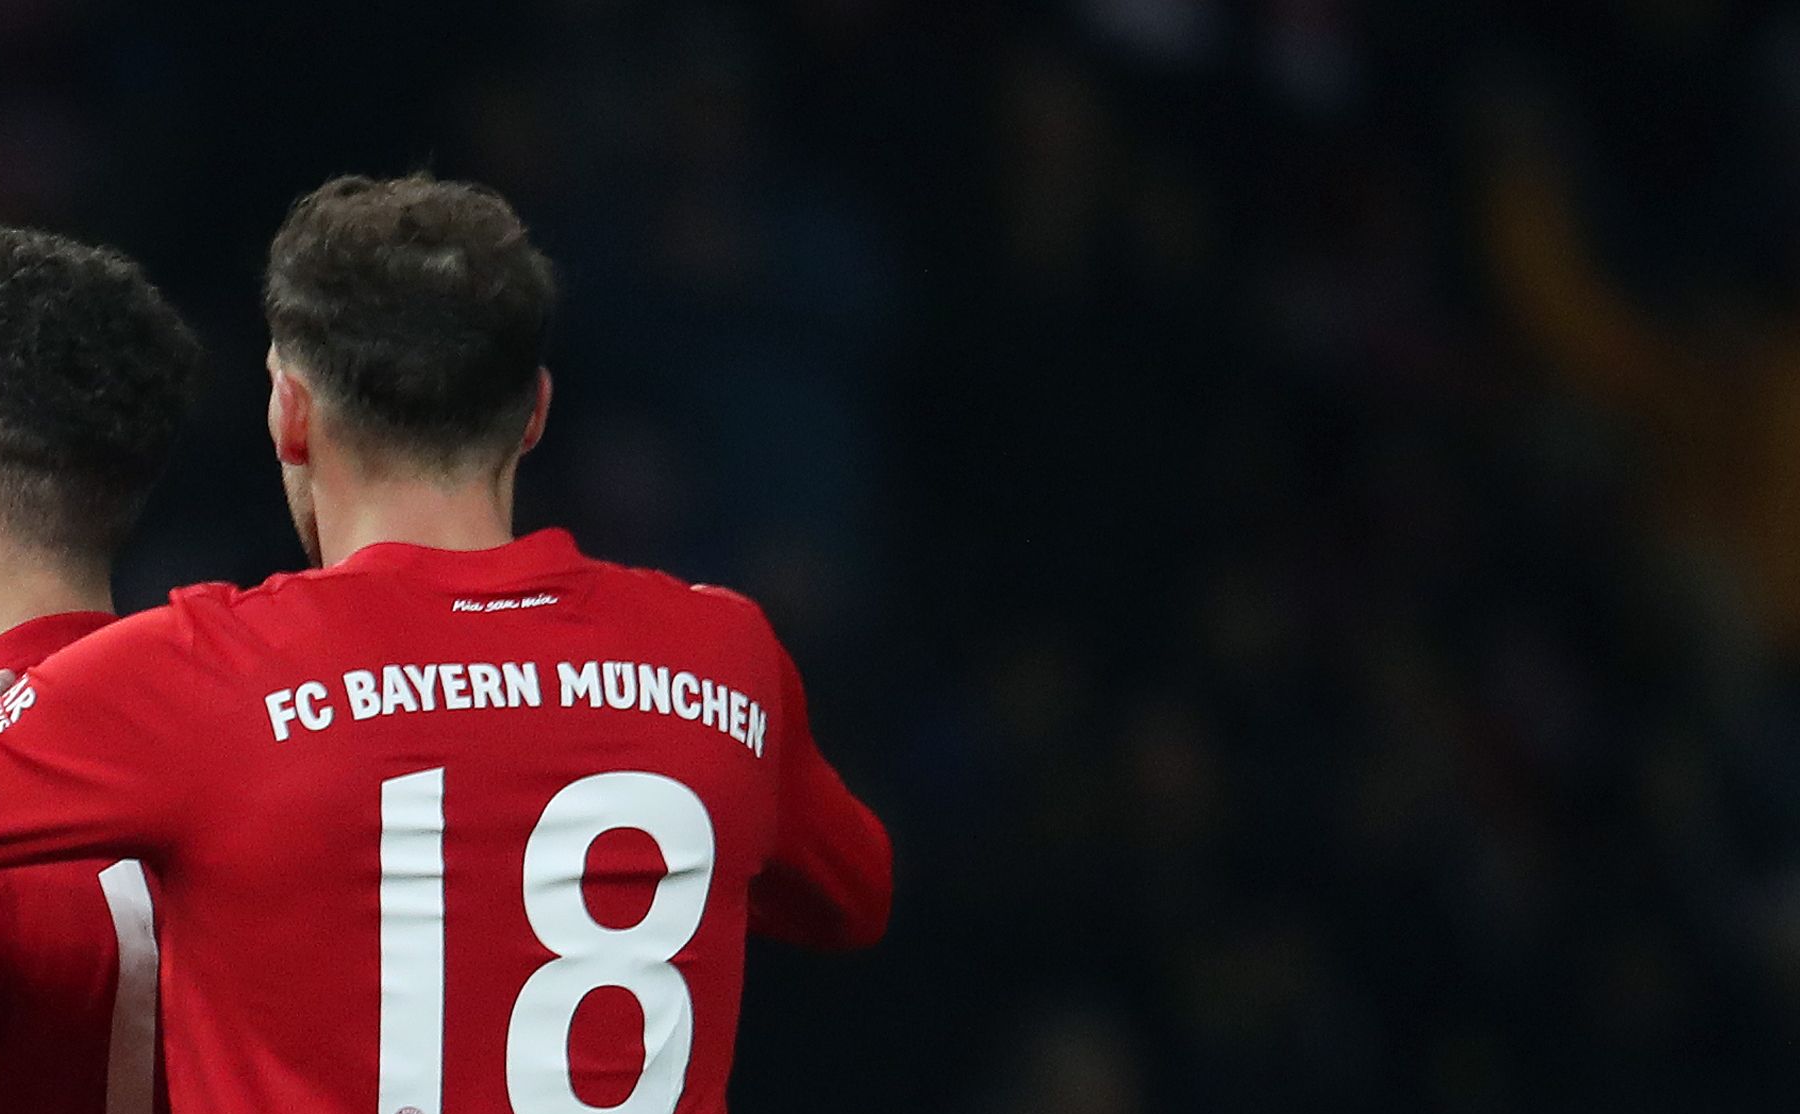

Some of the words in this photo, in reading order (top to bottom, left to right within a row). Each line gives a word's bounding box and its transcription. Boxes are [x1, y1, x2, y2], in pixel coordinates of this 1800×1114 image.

[265, 680, 333, 742] FC
[342, 661, 542, 721] BAYERN
[556, 660, 768, 758] MÜNCHEN
